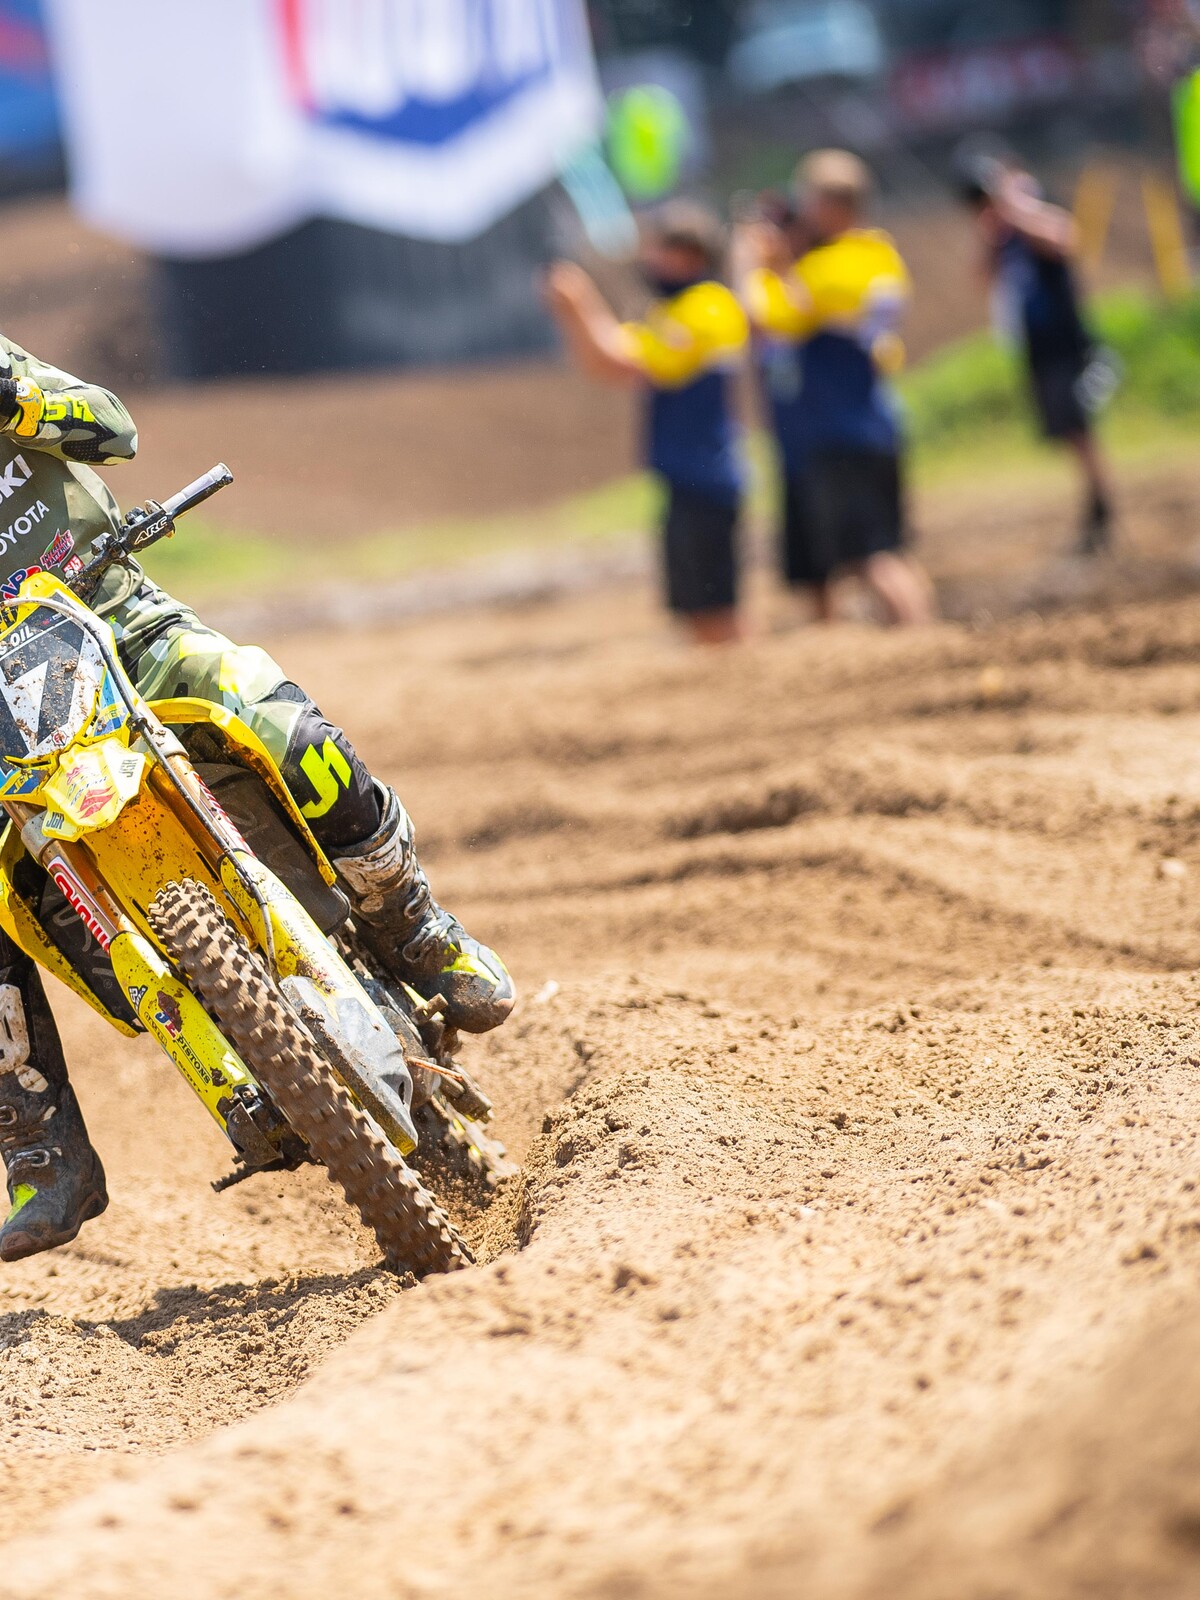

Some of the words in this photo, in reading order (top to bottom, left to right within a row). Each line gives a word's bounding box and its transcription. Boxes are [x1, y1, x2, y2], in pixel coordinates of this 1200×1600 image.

[133, 515, 169, 546] ARC
[1, 568, 29, 598] VP
[10, 625, 35, 649] OIL
[46, 811, 65, 830] JGR
[176, 1035, 211, 1085] PISTONS
